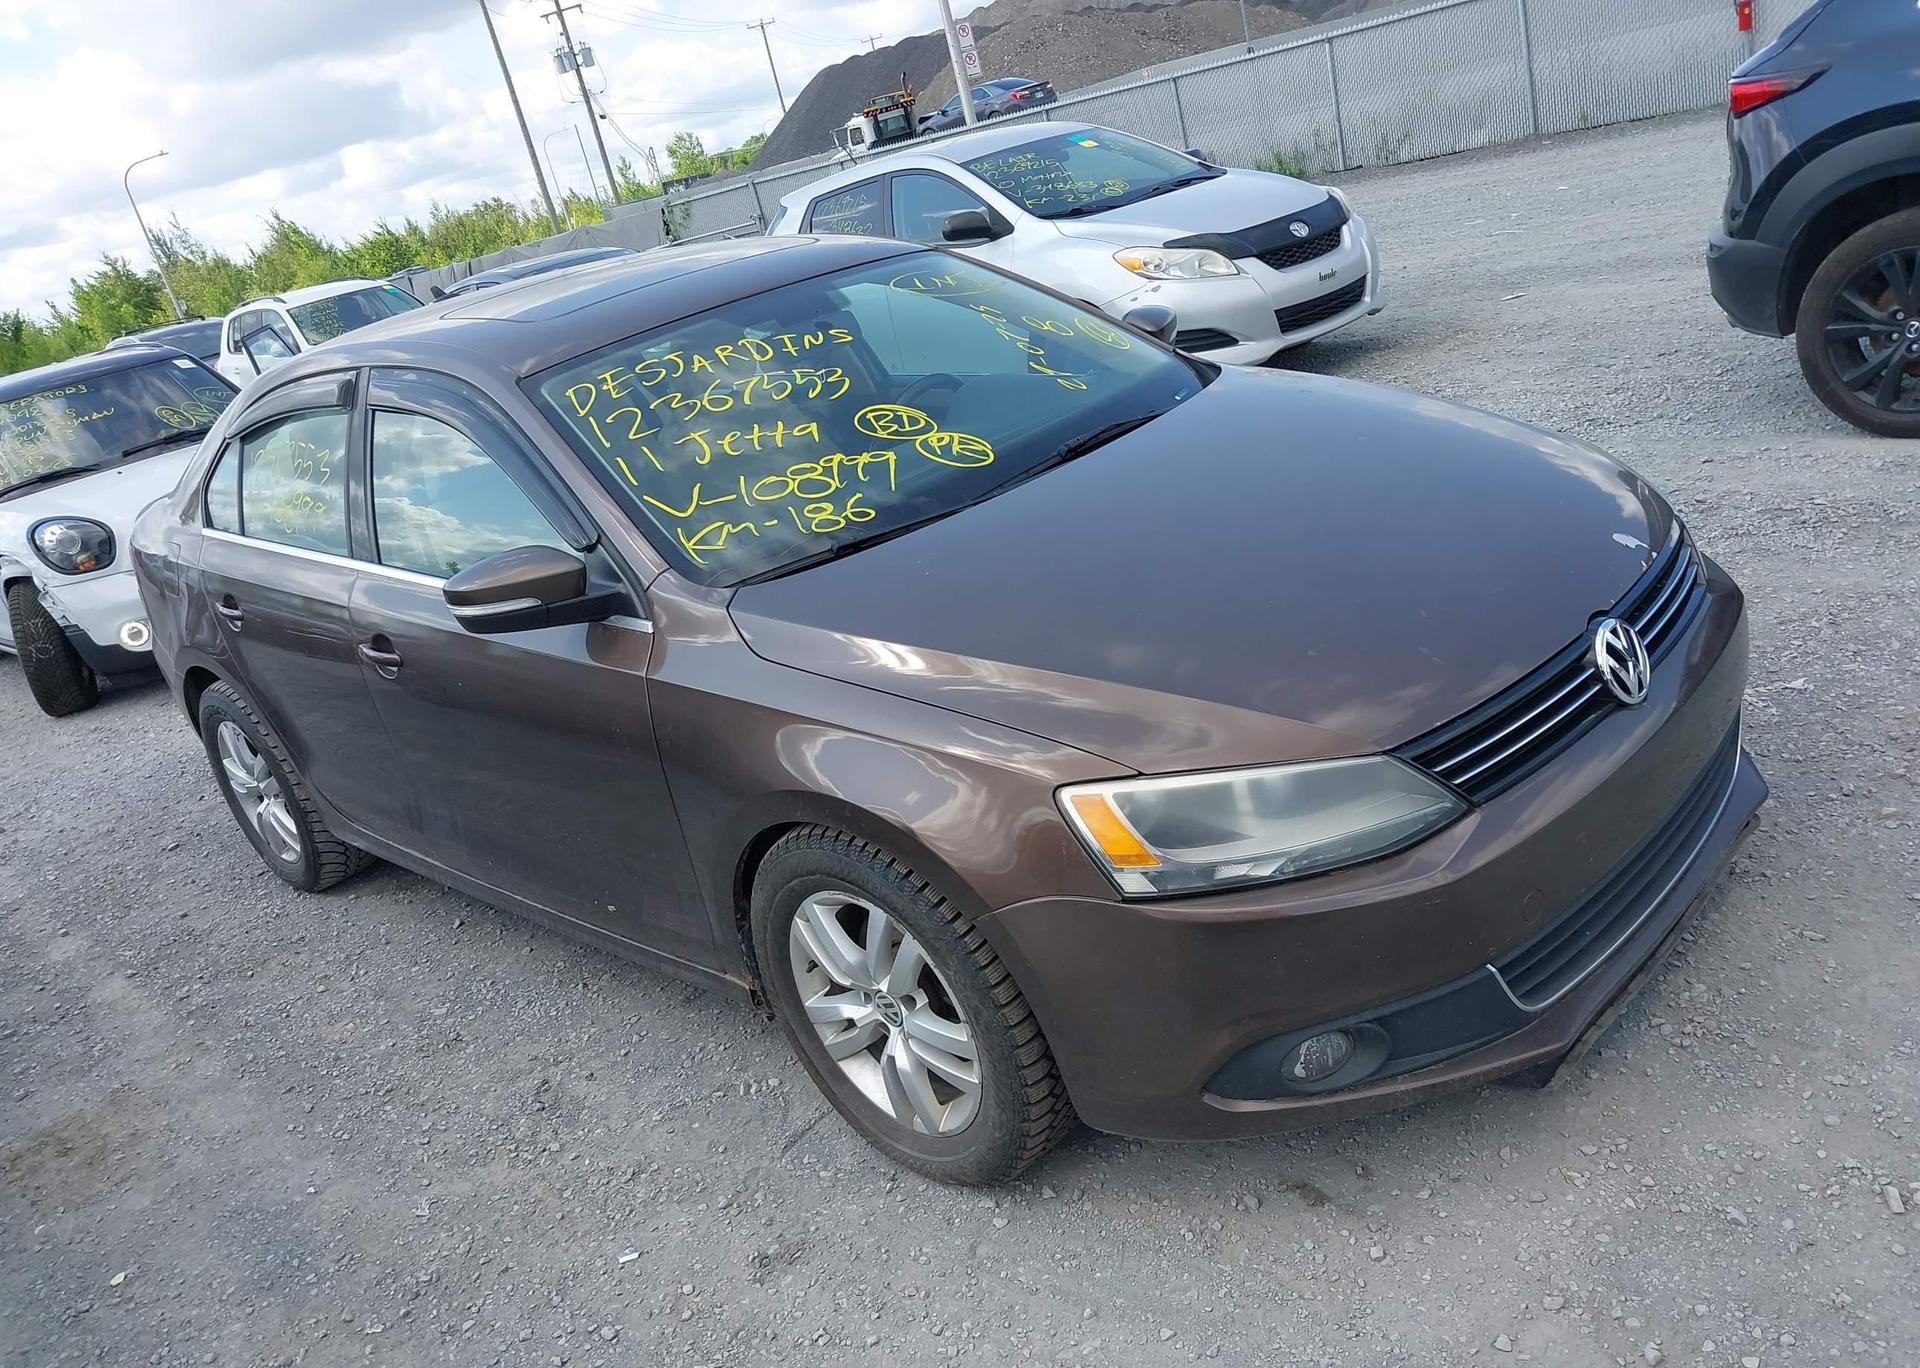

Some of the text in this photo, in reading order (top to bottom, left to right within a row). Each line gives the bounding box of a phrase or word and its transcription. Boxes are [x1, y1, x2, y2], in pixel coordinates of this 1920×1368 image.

[565, 329, 854, 416] DESJARDINS
[589, 367, 851, 448] 12367553
[864, 410, 928, 436] BD
[674, 421, 821, 464] Jetta
